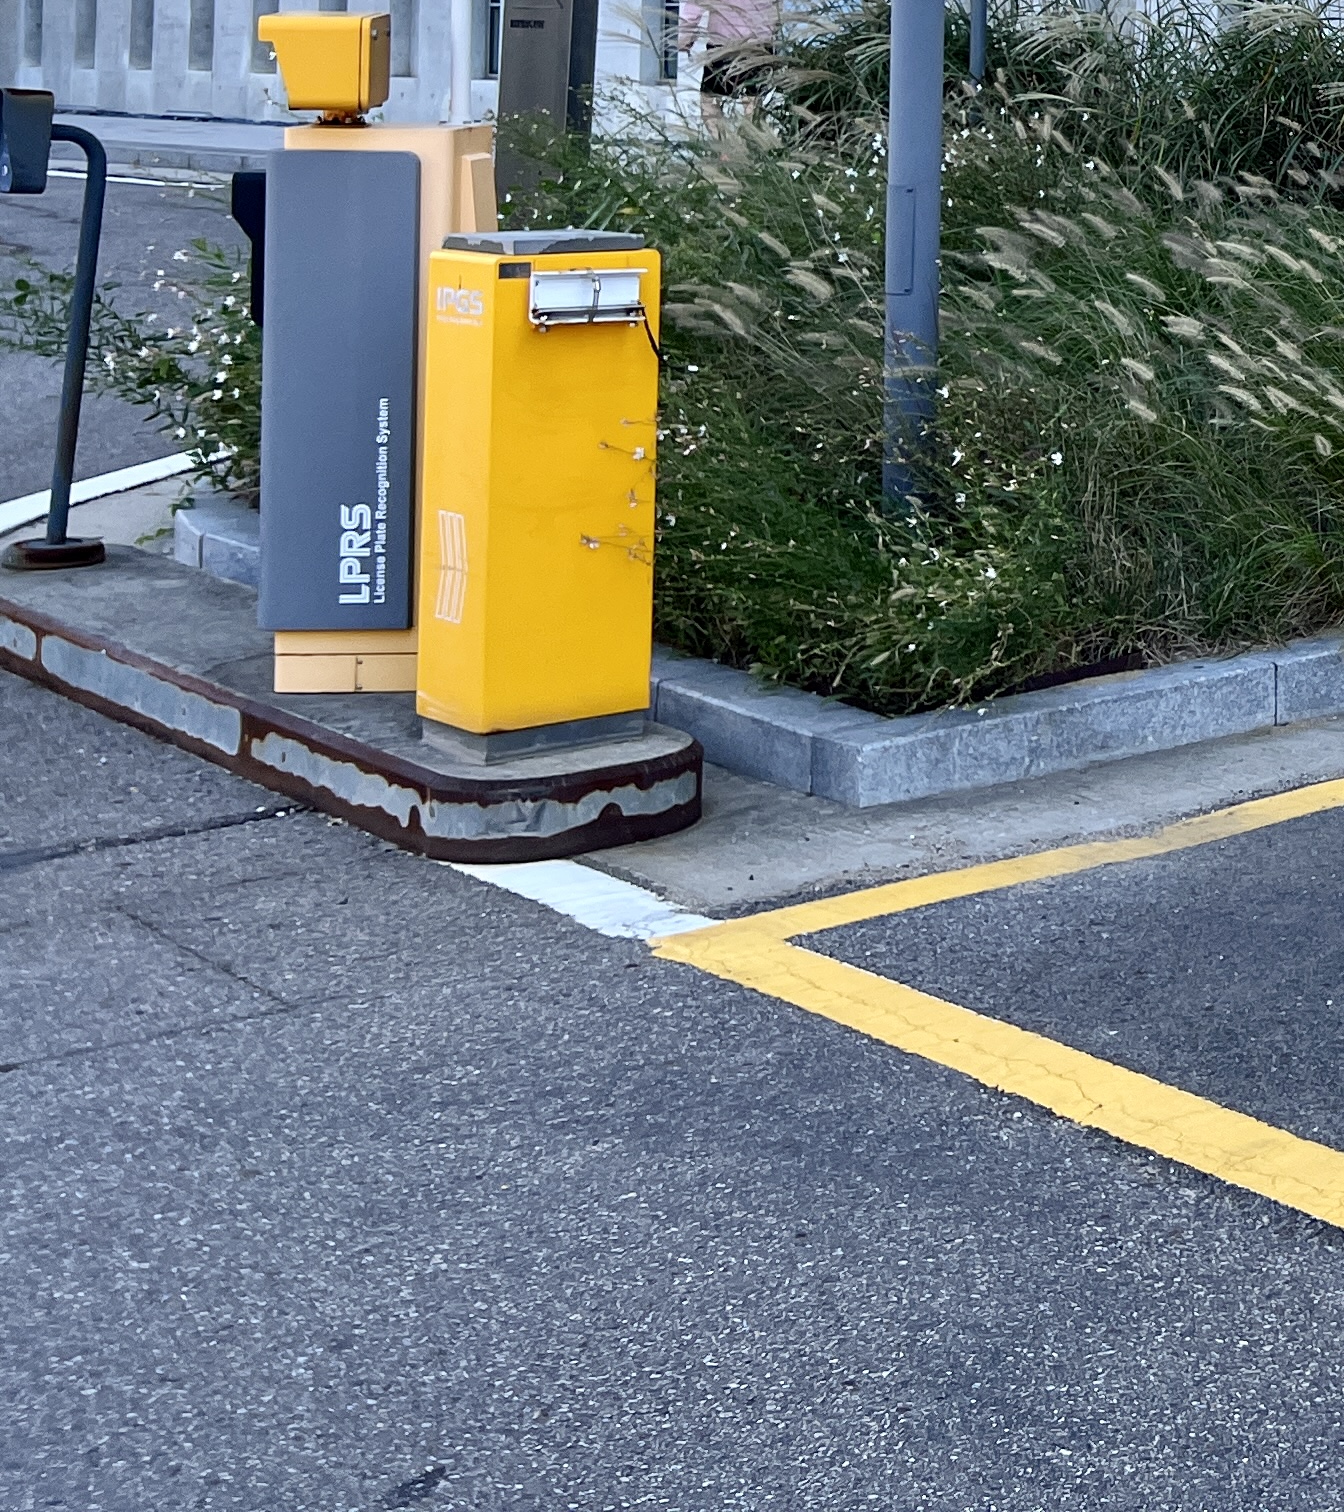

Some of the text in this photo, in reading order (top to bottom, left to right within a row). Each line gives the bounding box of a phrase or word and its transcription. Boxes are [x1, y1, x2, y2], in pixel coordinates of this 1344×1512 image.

[338, 503, 372, 604] LPRS
[373, 397, 391, 604] License Plate Recognition System
